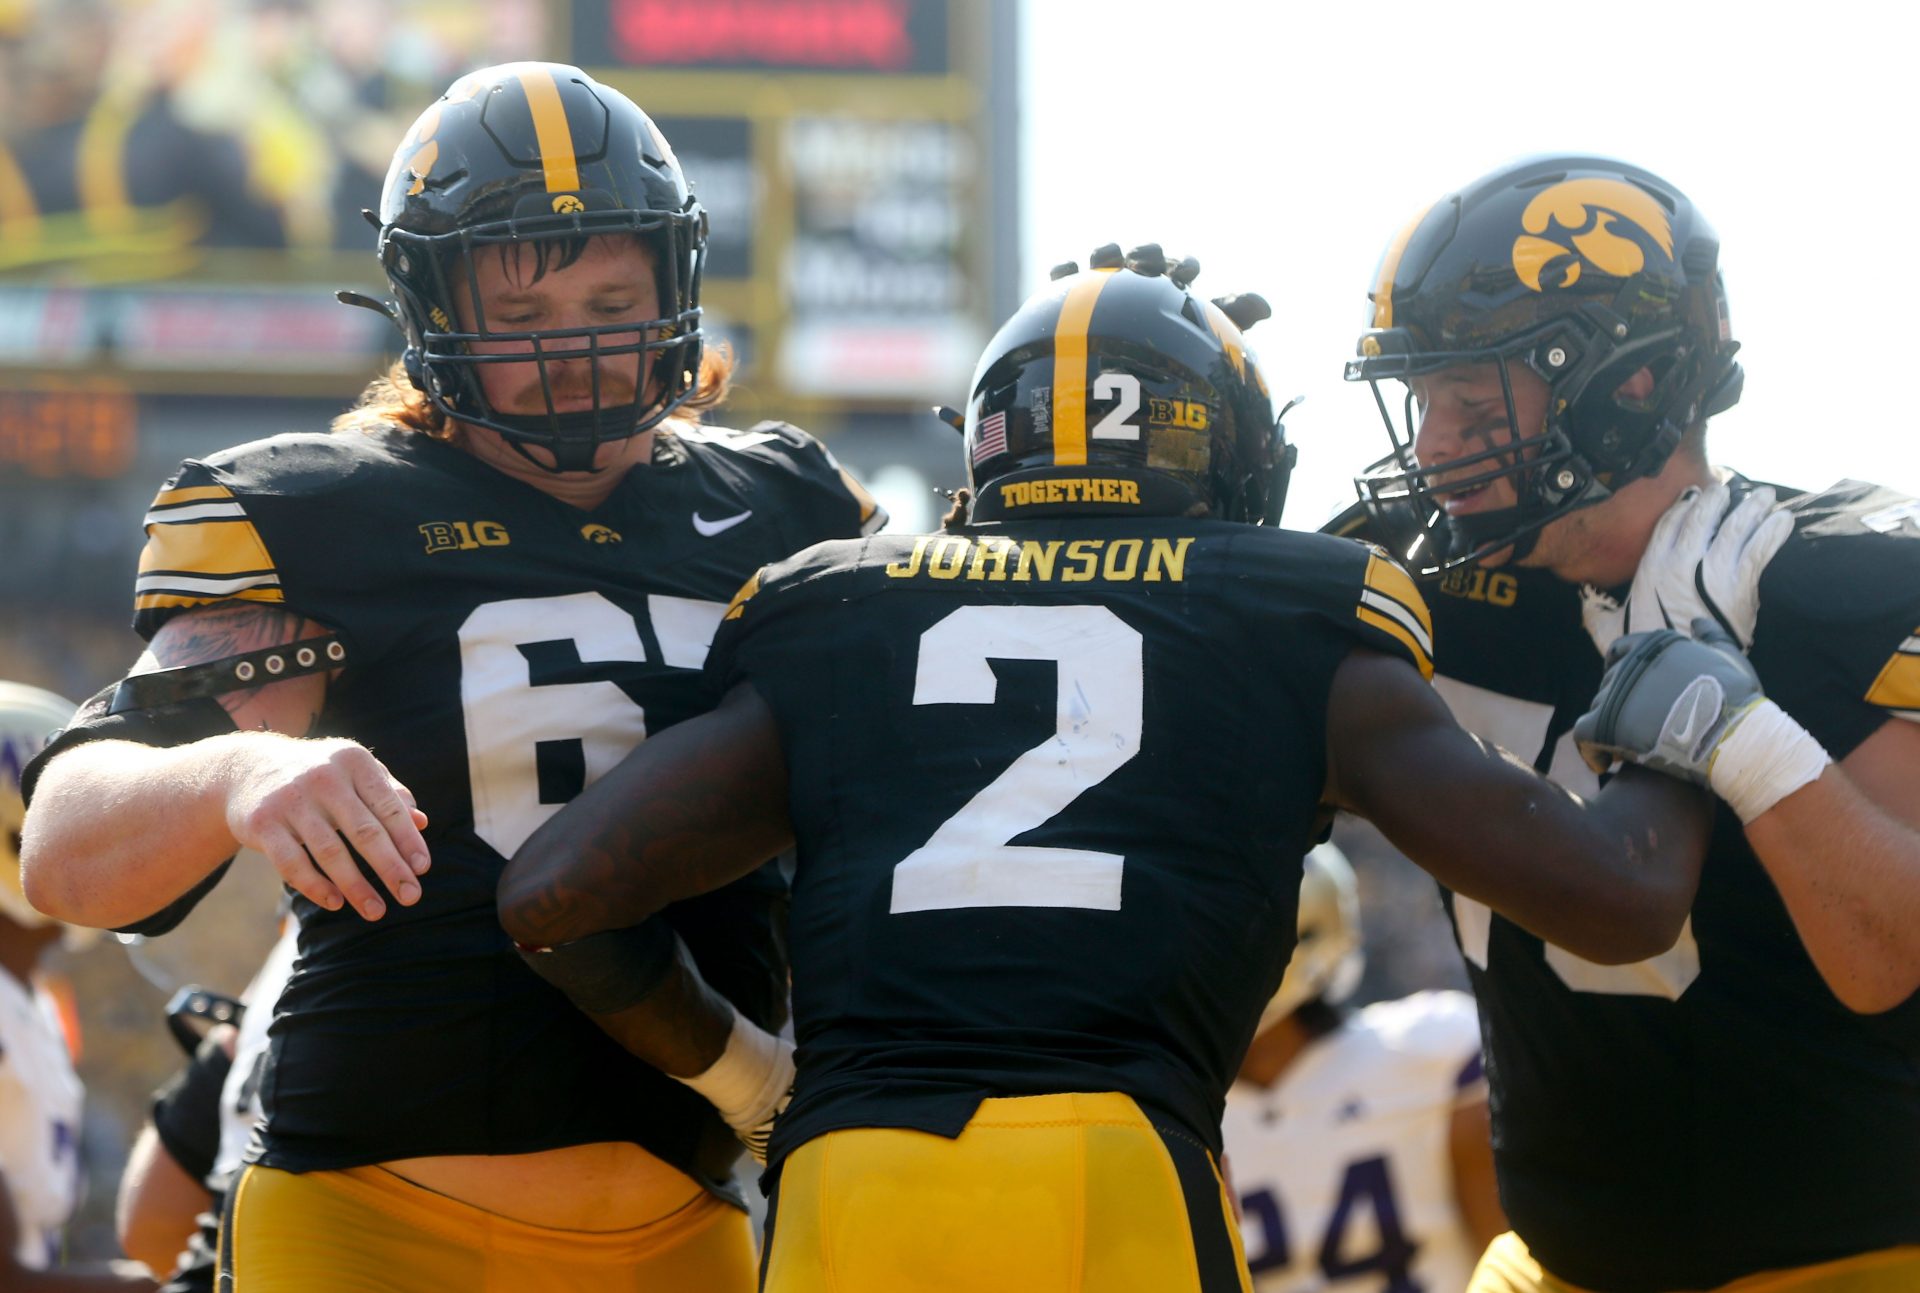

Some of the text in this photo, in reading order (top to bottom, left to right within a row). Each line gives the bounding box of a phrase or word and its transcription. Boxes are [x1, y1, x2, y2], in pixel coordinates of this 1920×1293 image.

[1092, 373, 1141, 441] 2
[1001, 478, 1141, 508] TOGETHER
[885, 536, 1196, 582] JOHNSON
[889, 604, 1144, 915] 2
